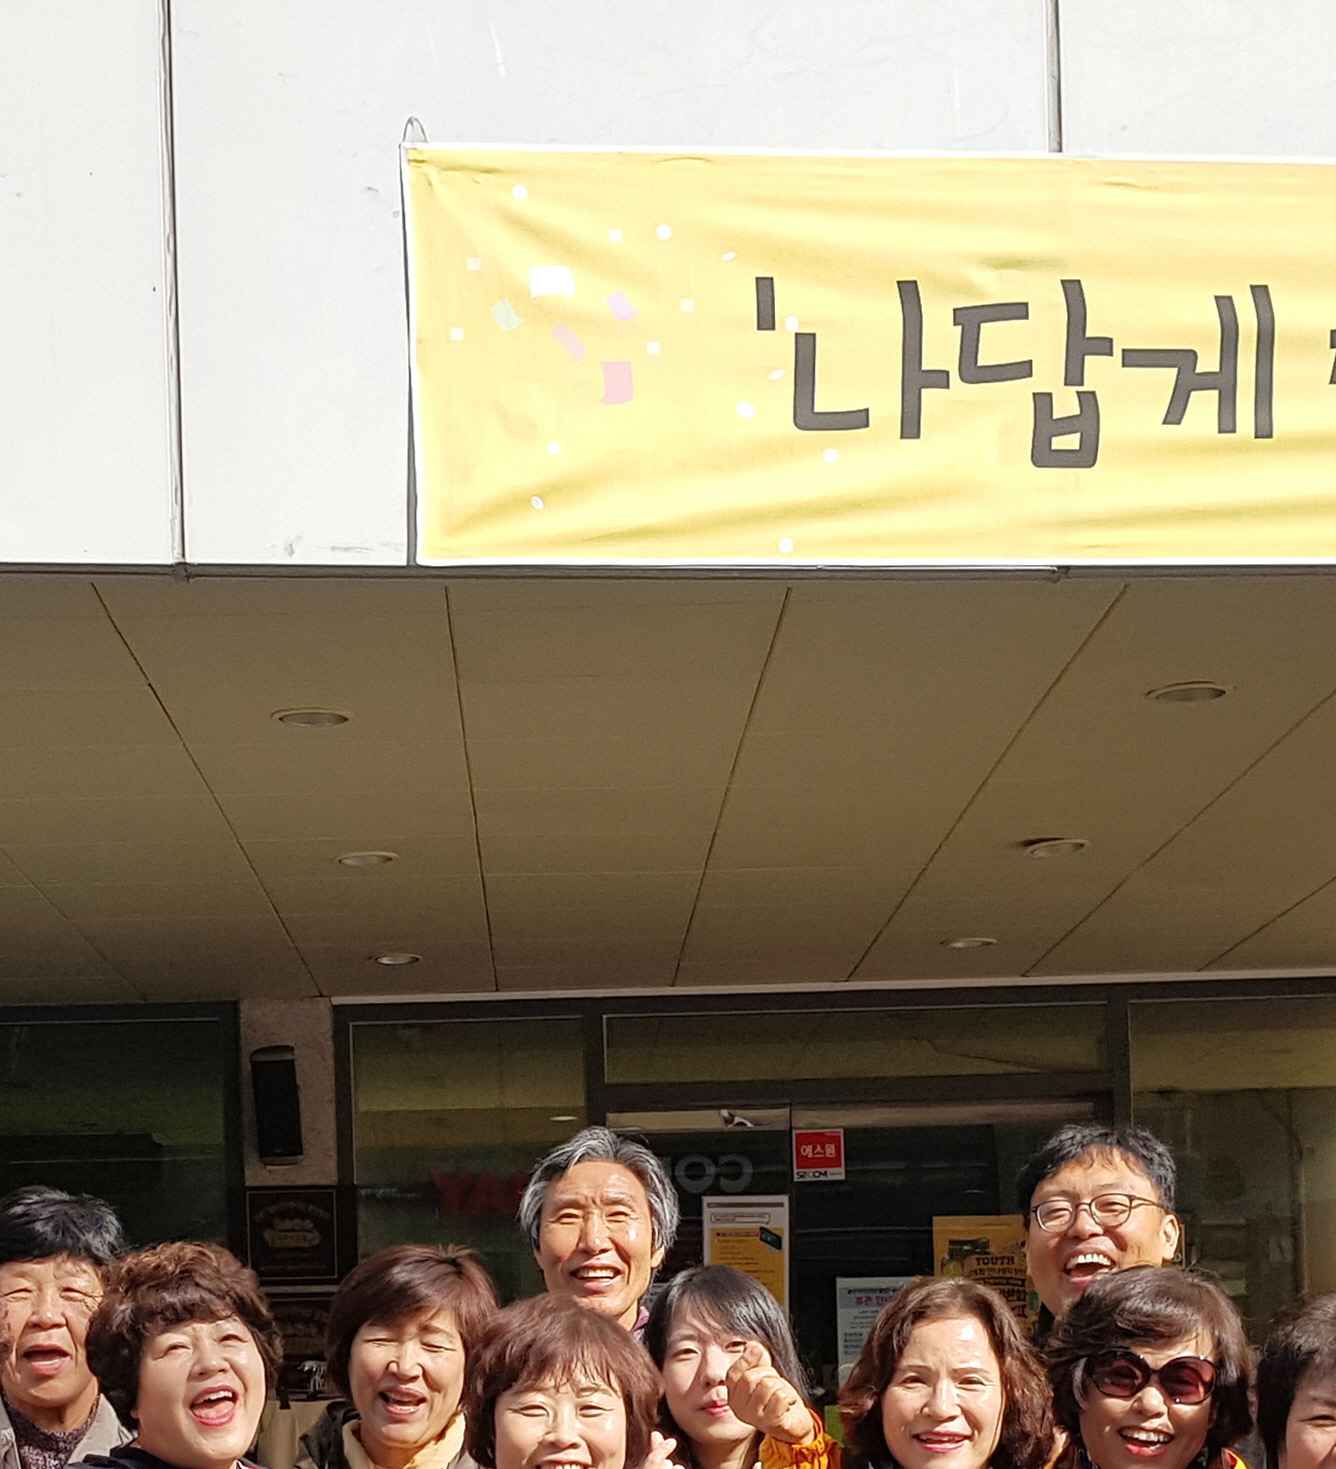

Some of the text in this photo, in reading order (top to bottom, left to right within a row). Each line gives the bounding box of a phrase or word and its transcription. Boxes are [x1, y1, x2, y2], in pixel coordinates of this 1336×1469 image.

[755, 276, 1276, 469] '나답게
[800, 1143, 835, 1158] 에스원
[975, 1255, 1015, 1266] YOUTH
